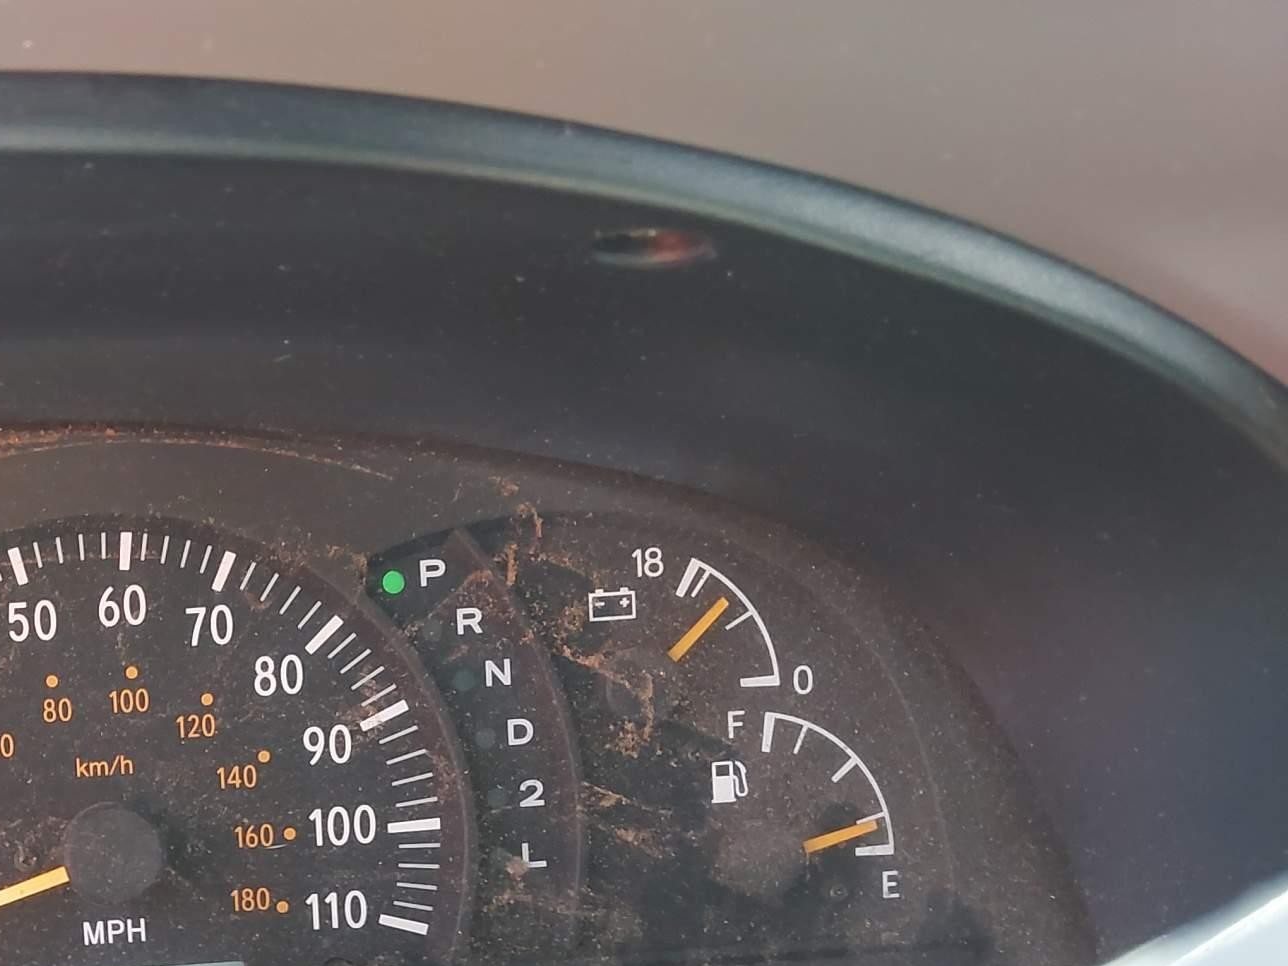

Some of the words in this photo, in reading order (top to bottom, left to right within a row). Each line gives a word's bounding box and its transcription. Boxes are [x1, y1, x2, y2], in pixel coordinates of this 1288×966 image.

[418, 559, 446, 587] P
[631, 547, 664, 578] 18
[98, 585, 147, 627] 60
[7, 600, 57, 642] 50
[185, 605, 234, 647] 70
[457, 607, 483, 635] R
[253, 654, 304, 697] 80
[484, 658, 512, 688] N
[42, 699, 72, 723] 80
[108, 689, 149, 713] 100
[176, 714, 216, 739] 120
[507, 718, 534, 746] D
[727, 710, 745, 739] F
[303, 724, 352, 766] 90
[75, 756, 134, 778] km/h
[216, 765, 257, 789] 140
[518, 780, 545, 808] 2
[234, 824, 274, 848] 160
[308, 804, 376, 846] 100
[521, 843, 547, 868] L
[882, 870, 900, 899] E
[230, 888, 270, 912] 180
[305, 889, 368, 931] 110
[83, 918, 146, 945] MPH
